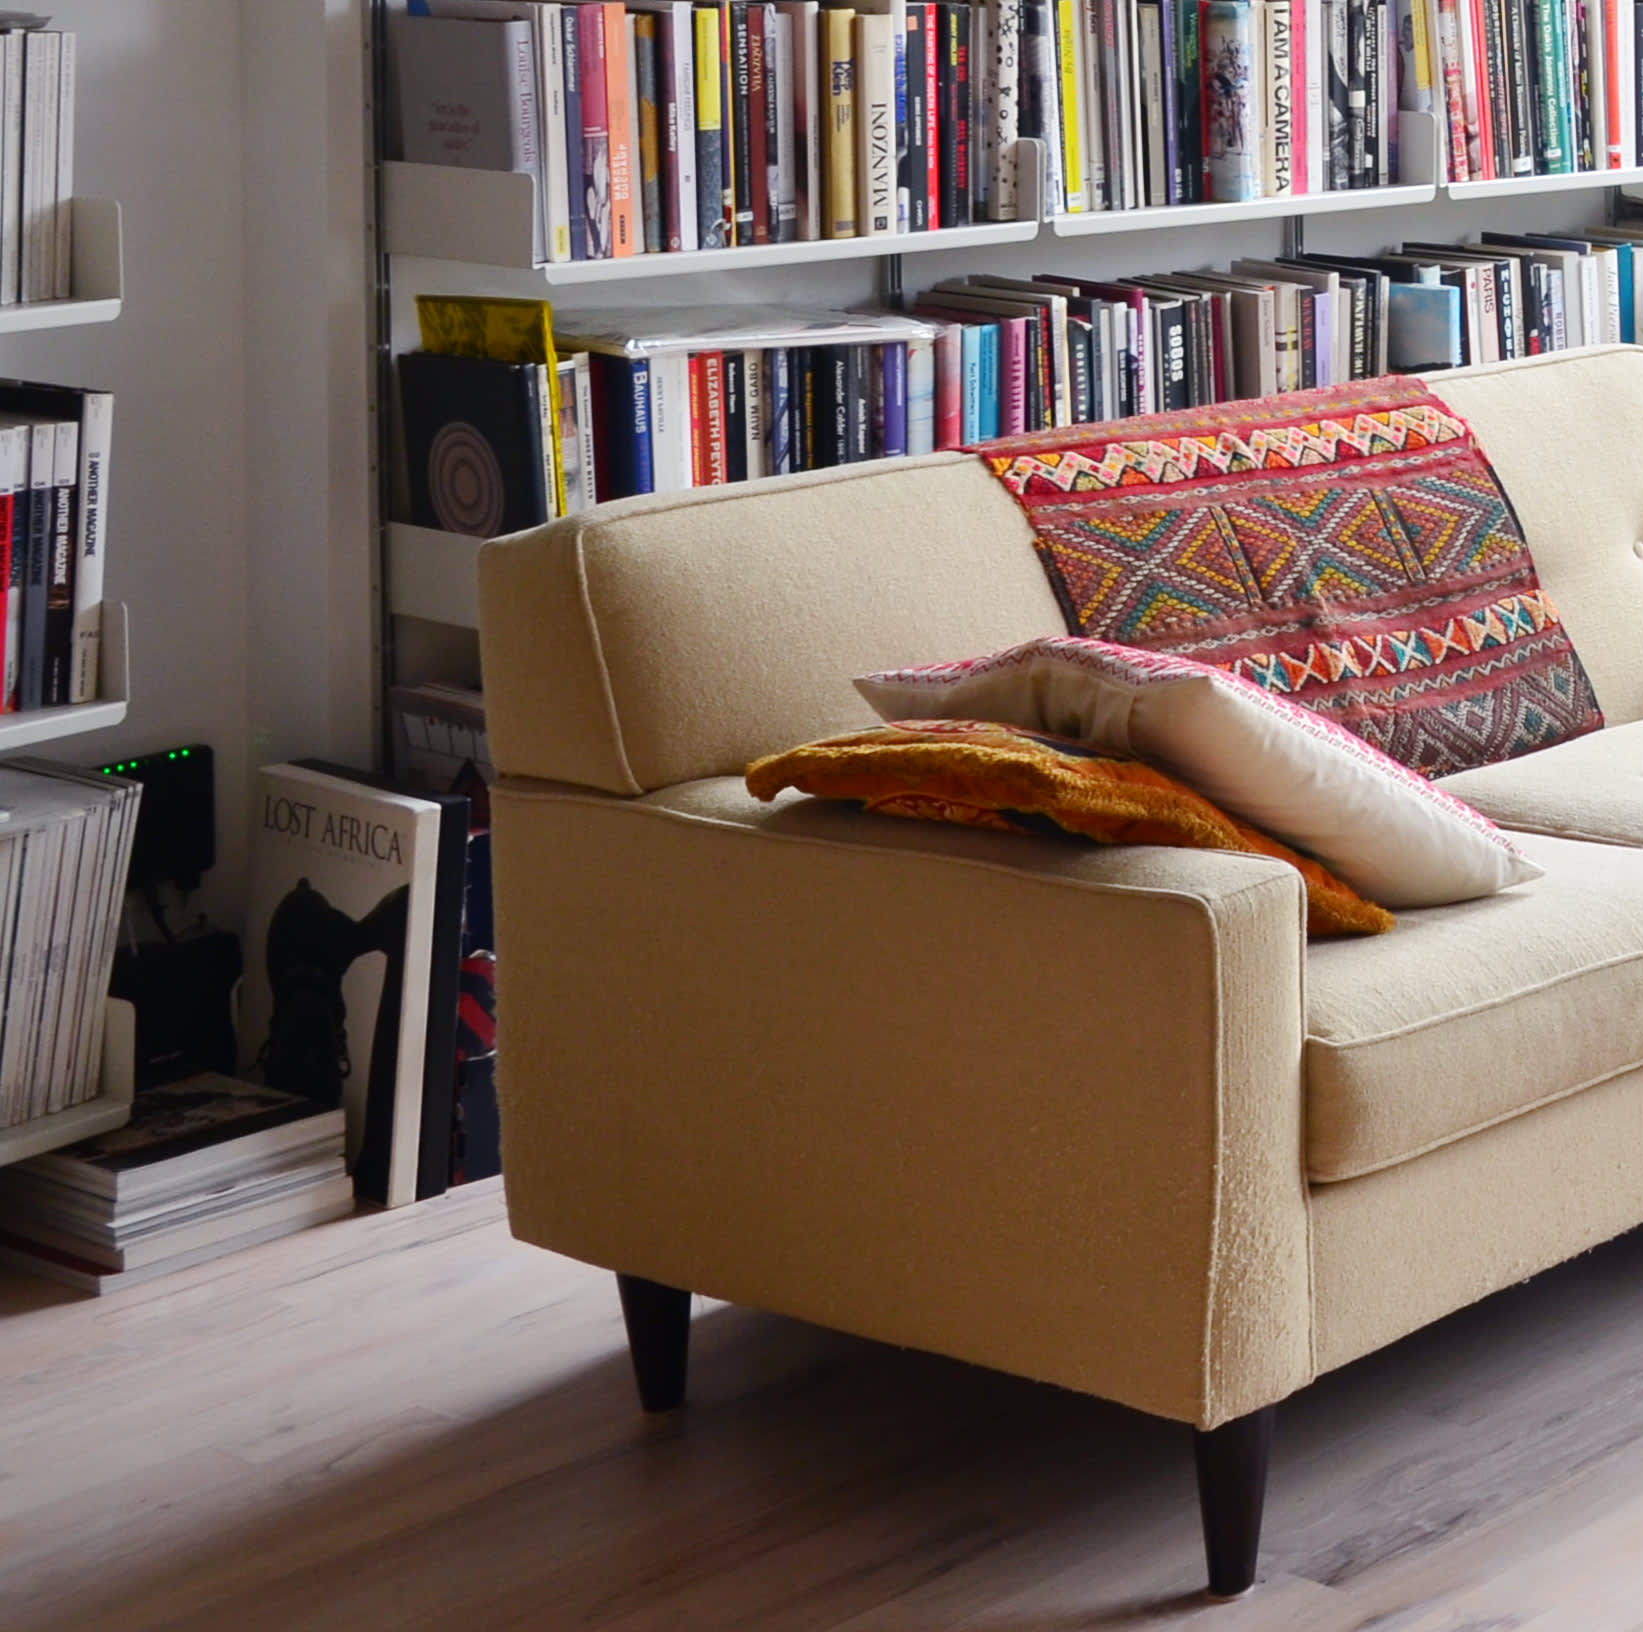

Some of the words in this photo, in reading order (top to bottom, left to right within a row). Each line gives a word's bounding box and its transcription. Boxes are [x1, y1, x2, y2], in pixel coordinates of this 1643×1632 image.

[566, 16, 575, 42] Oskar
[1542, 4, 1551, 20] The
[737, 24, 748, 95] SENSATION
[1275, 20, 1289, 59] AM
[1543, 24, 1554, 51] Dakis
[517, 40, 532, 86] Louise
[566, 44, 576, 93] Schlemmer
[833, 62, 843, 96] Klein
[1275, 64, 1289, 82] A
[1545, 56, 1556, 96] Joannou
[519, 93, 536, 163] Bourgeois
[1275, 85, 1290, 192] CAMERA
[1547, 98, 1560, 148] Collection
[871, 104, 888, 206] MANZONI
[1482, 268, 1495, 314] PARIS
[1554, 311, 1565, 351] ROBER
[706, 358, 720, 438] ELIZABETH
[749, 362, 759, 397] GABO
[835, 360, 846, 404] Alexander
[633, 371, 648, 435] BAUHAUS
[750, 405, 761, 441] NAUM
[836, 406, 846, 436] Calder
[857, 424, 867, 454] Kapoor
[86, 460, 99, 505] ANOTHER
[710, 442, 722, 486] PEYTO
[32, 489, 45, 533] ANOTHER
[56, 488, 69, 533] ANOTHER
[84, 508, 98, 558] MAGAZINE
[31, 536, 44, 586] MAGAZINE
[54, 535, 68, 585] MAGAZINE
[264, 794, 318, 839] LOST
[321, 811, 403, 866] AFRICA
